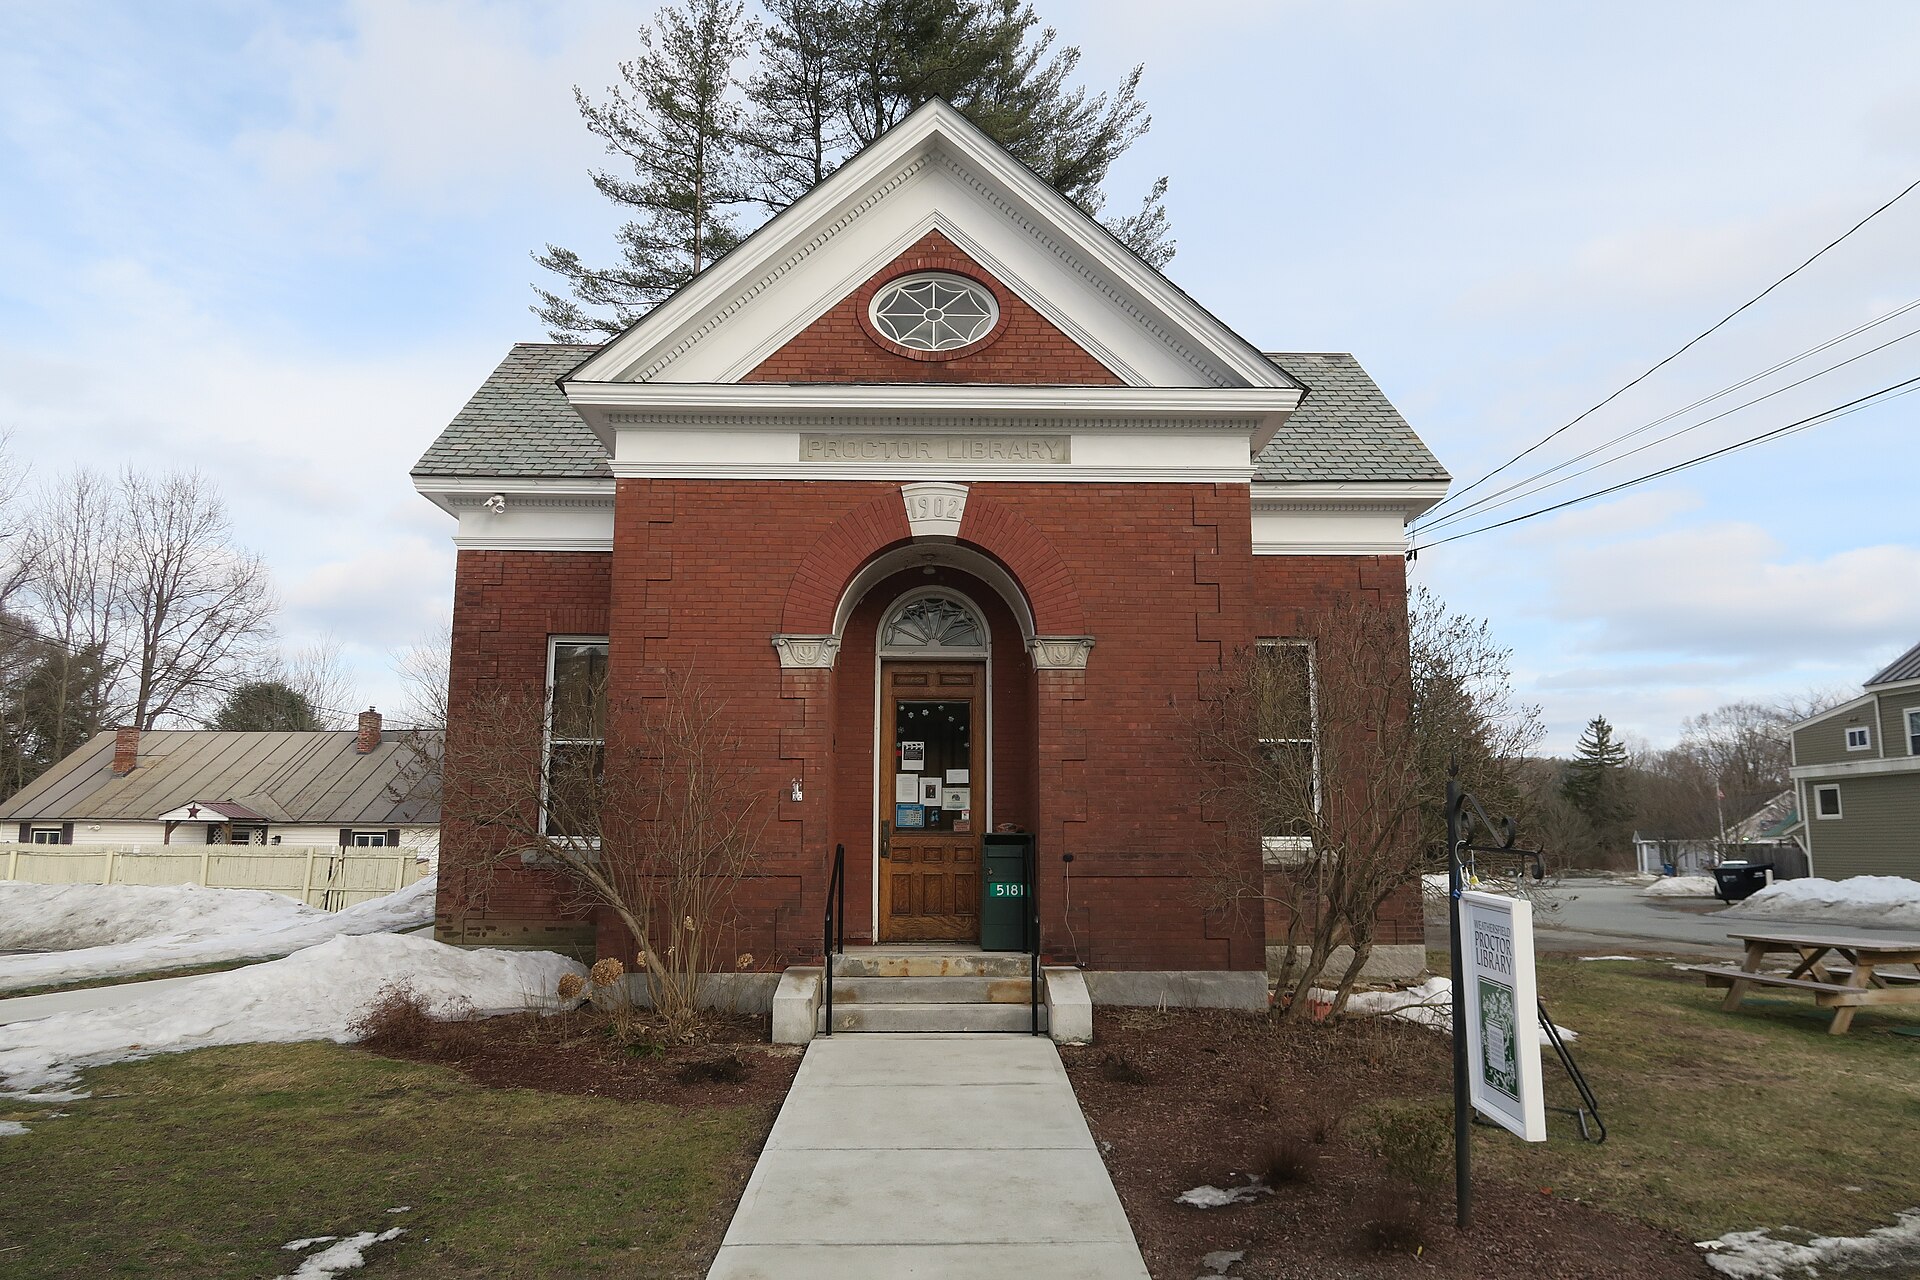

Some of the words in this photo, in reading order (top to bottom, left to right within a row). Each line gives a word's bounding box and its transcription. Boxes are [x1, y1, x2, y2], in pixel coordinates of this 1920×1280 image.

[806, 439, 932, 459] PROCTOR
[946, 438, 1059, 460] LIBRARY
[908, 496, 960, 520] 1902
[996, 884, 1024, 896] 5181
[1473, 919, 1511, 938] WEATHERSFIELD
[1474, 930, 1512, 957] PROCTOR
[1475, 946, 1512, 976] LIBRARY
